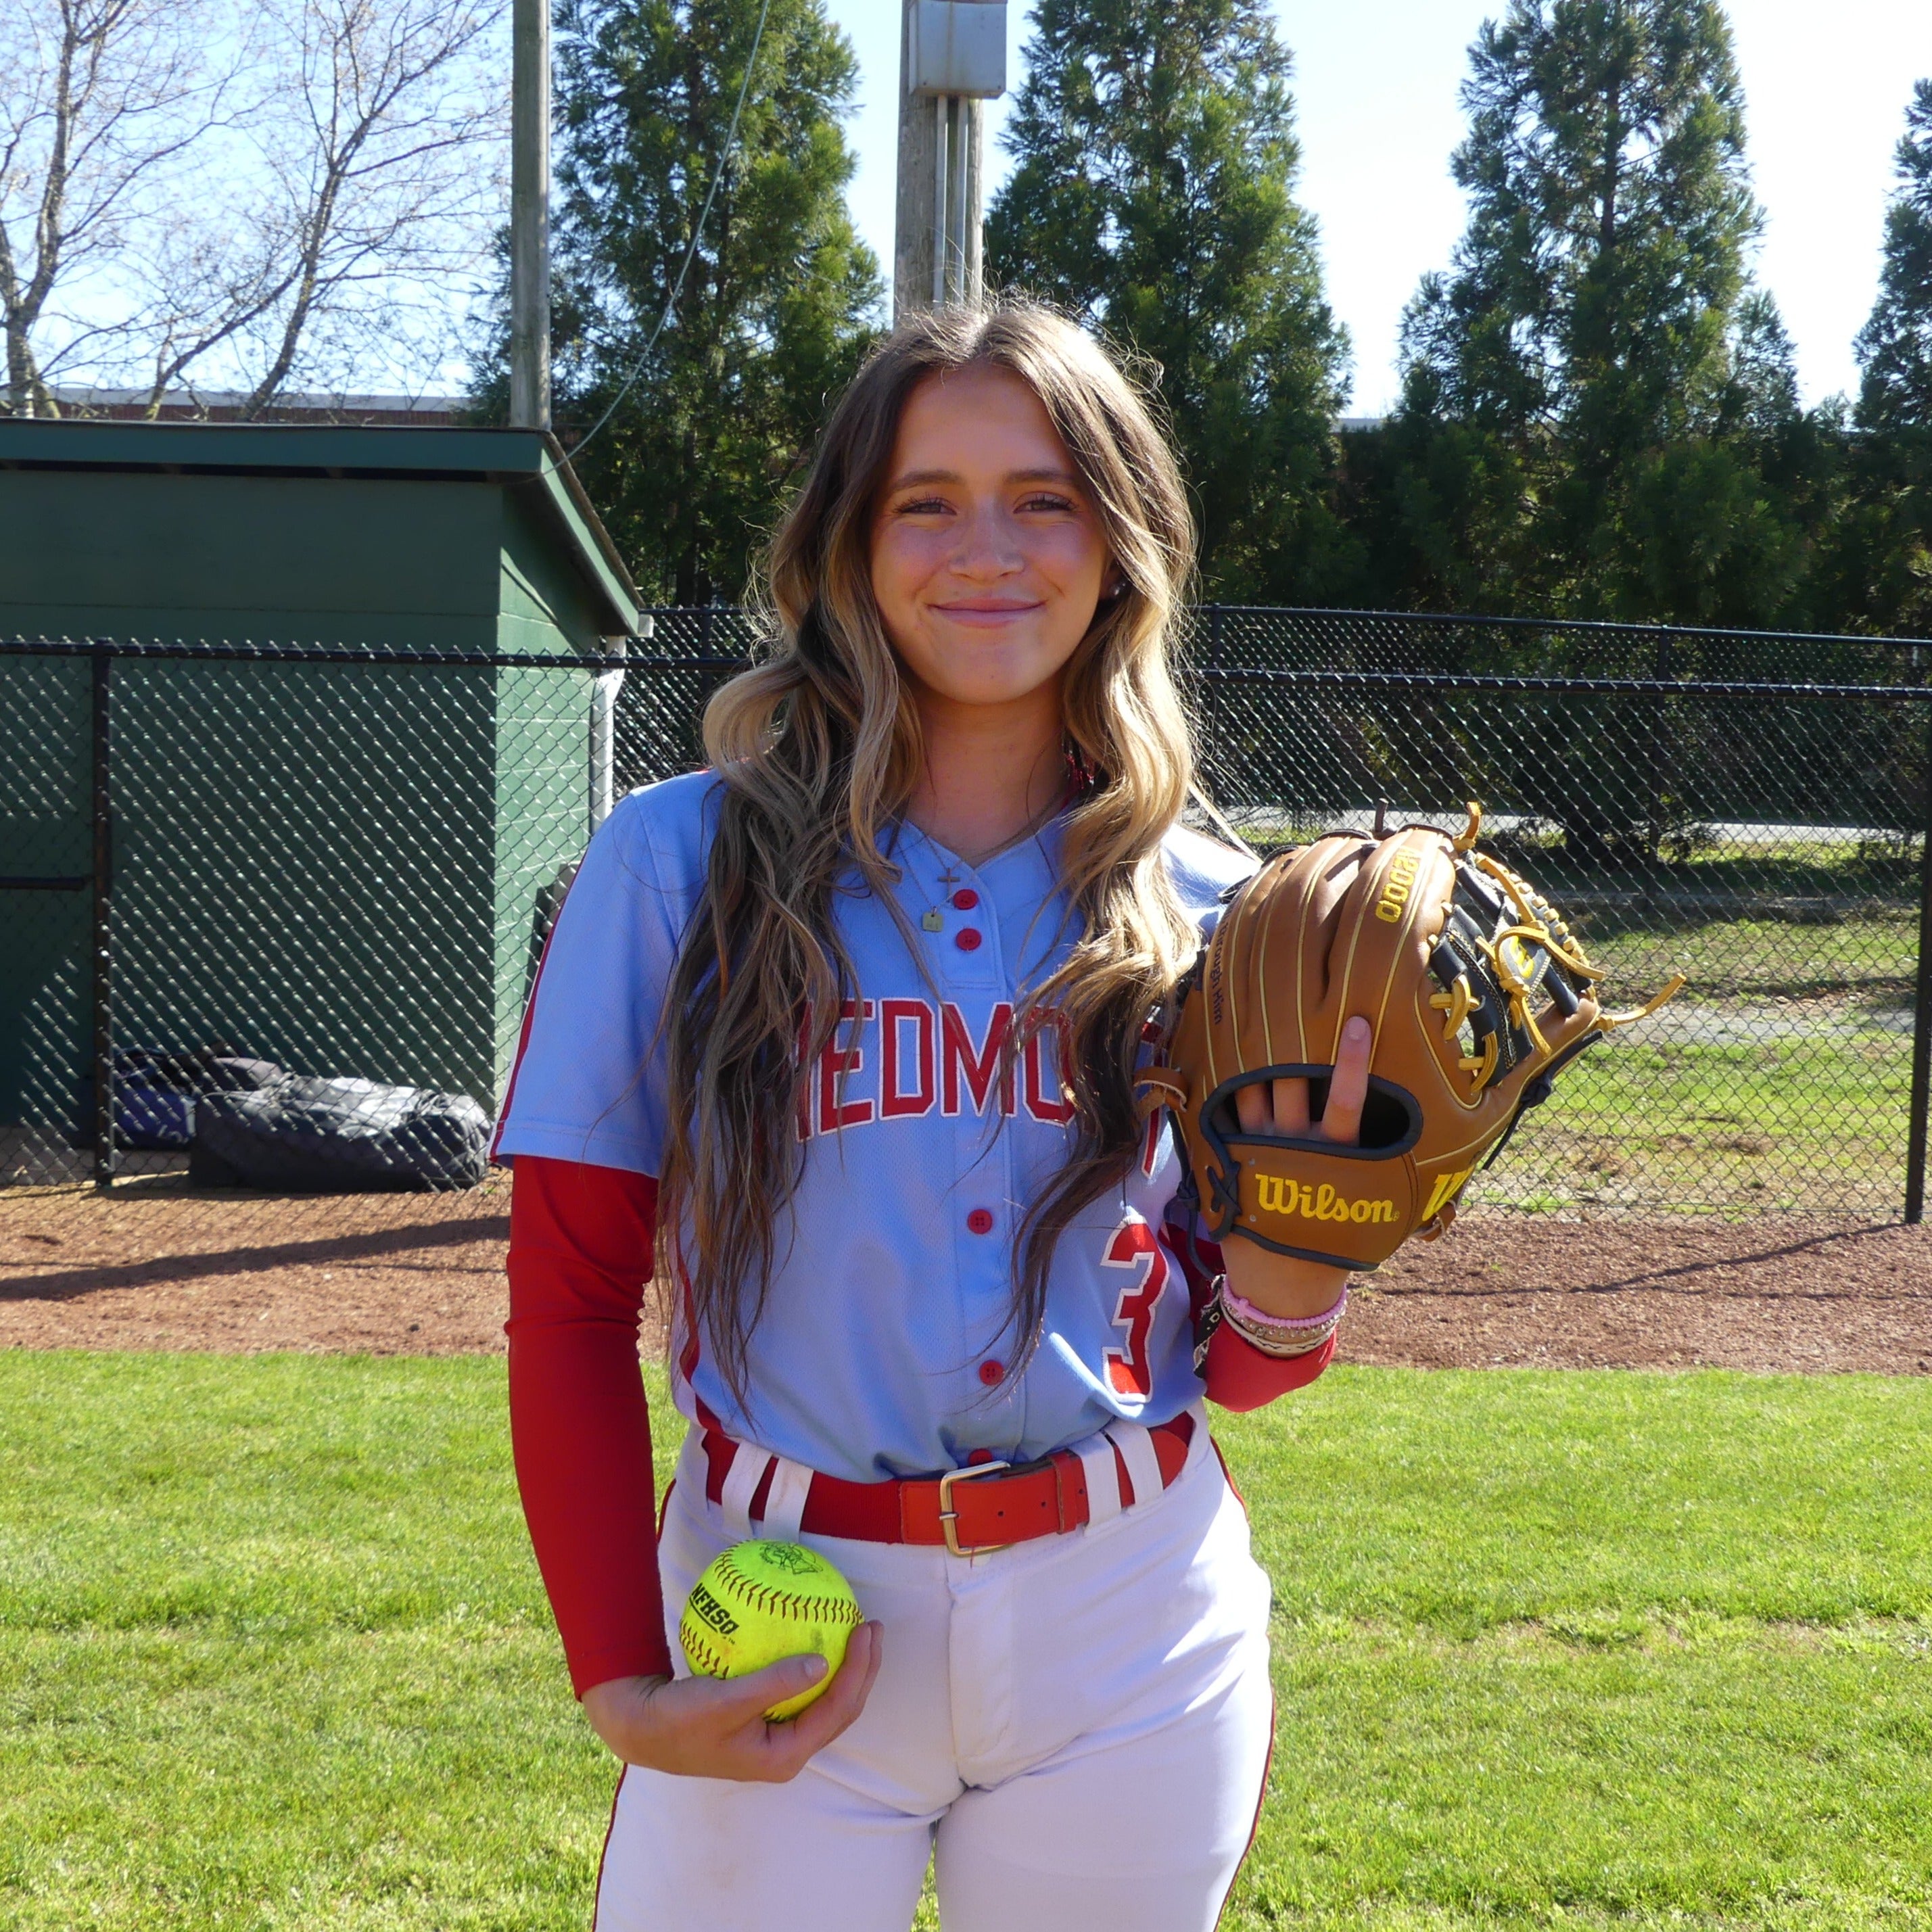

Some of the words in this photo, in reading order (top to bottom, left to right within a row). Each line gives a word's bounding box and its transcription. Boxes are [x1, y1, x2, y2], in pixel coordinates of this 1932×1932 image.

[1375, 847, 1420, 922] A2000
[1255, 1174, 1394, 1223] Wilson
[1101, 1215, 1170, 1403] 3
